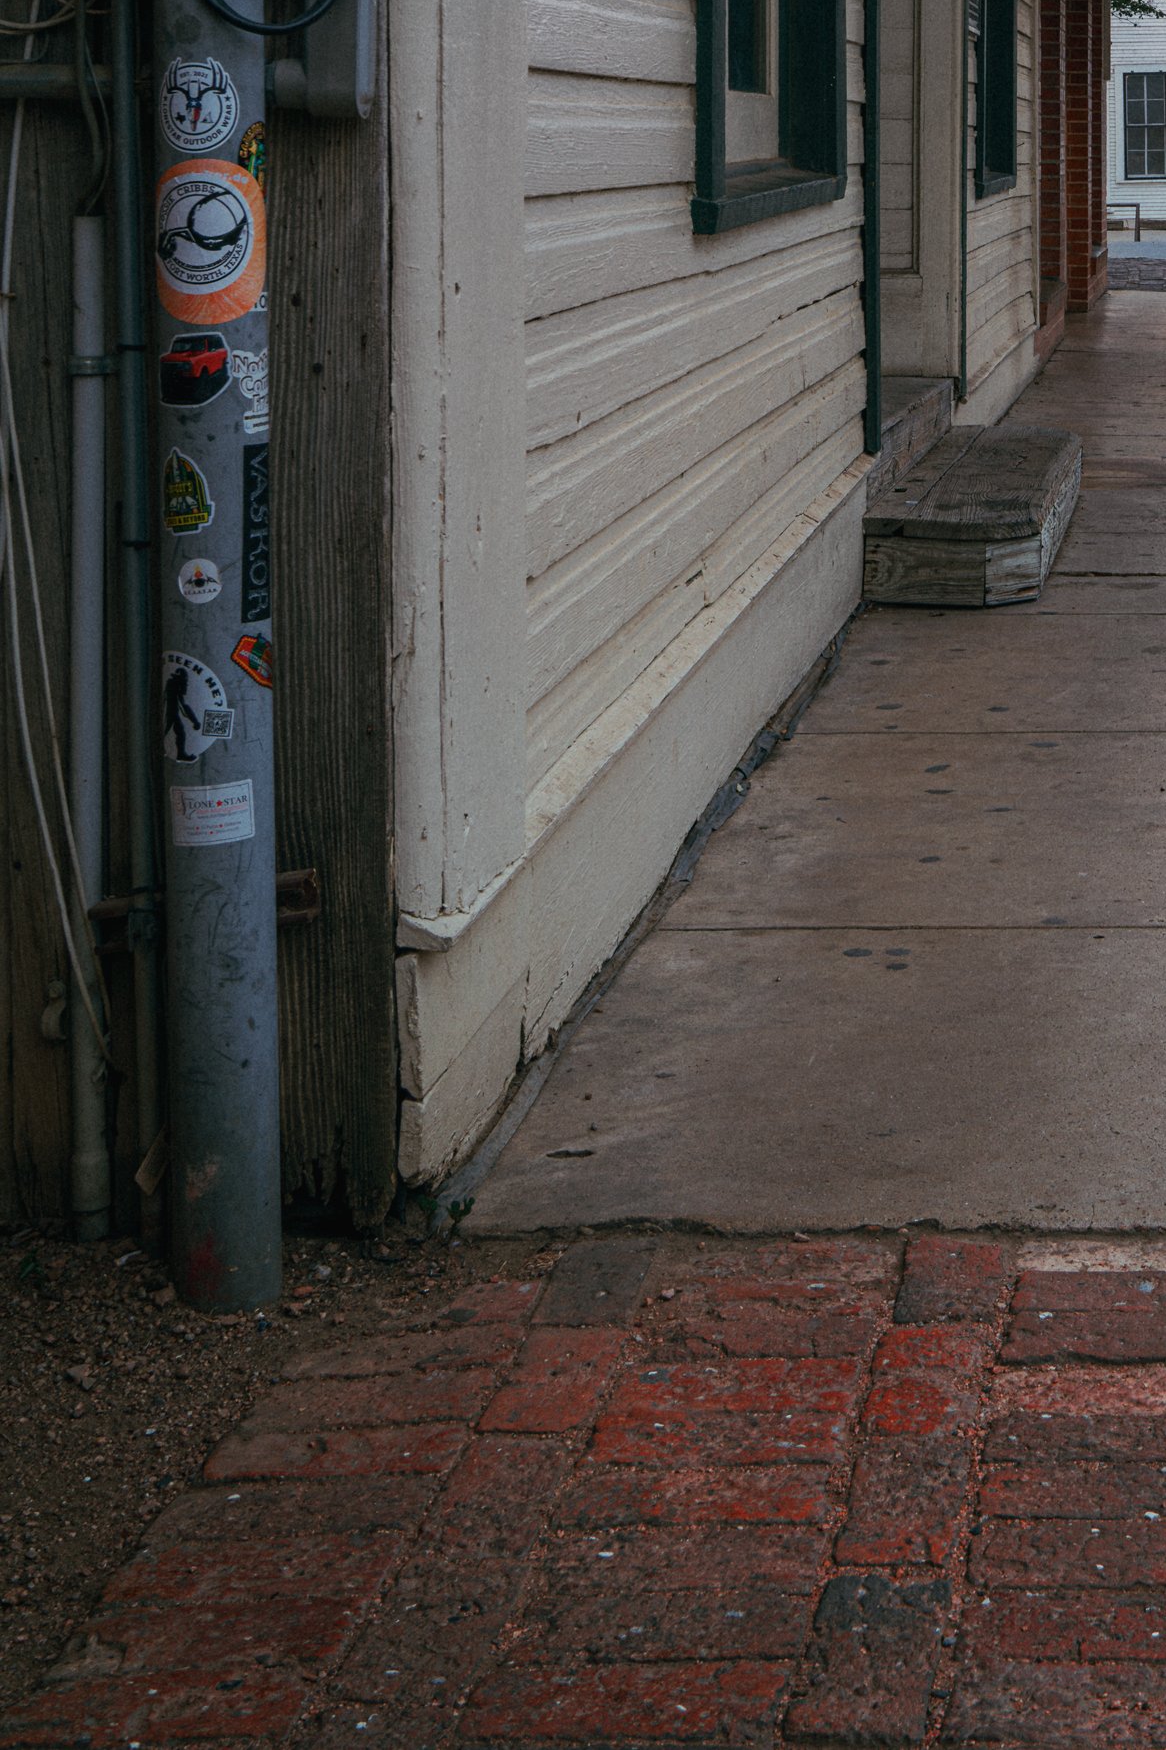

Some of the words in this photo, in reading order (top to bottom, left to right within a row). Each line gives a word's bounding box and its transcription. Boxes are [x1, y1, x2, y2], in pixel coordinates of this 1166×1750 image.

[183, 128, 224, 146] OUTDOOR
[221, 103, 233, 128] WEAR
[176, 184, 216, 196] CRIBBS
[166, 259, 190, 278] FORT
[228, 243, 249, 270] TEXAS
[168, 654, 203, 676] SEEN
[205, 676, 224, 707] ME?
[188, 799, 215, 810] LONE
[223, 794, 249, 807] STAR
